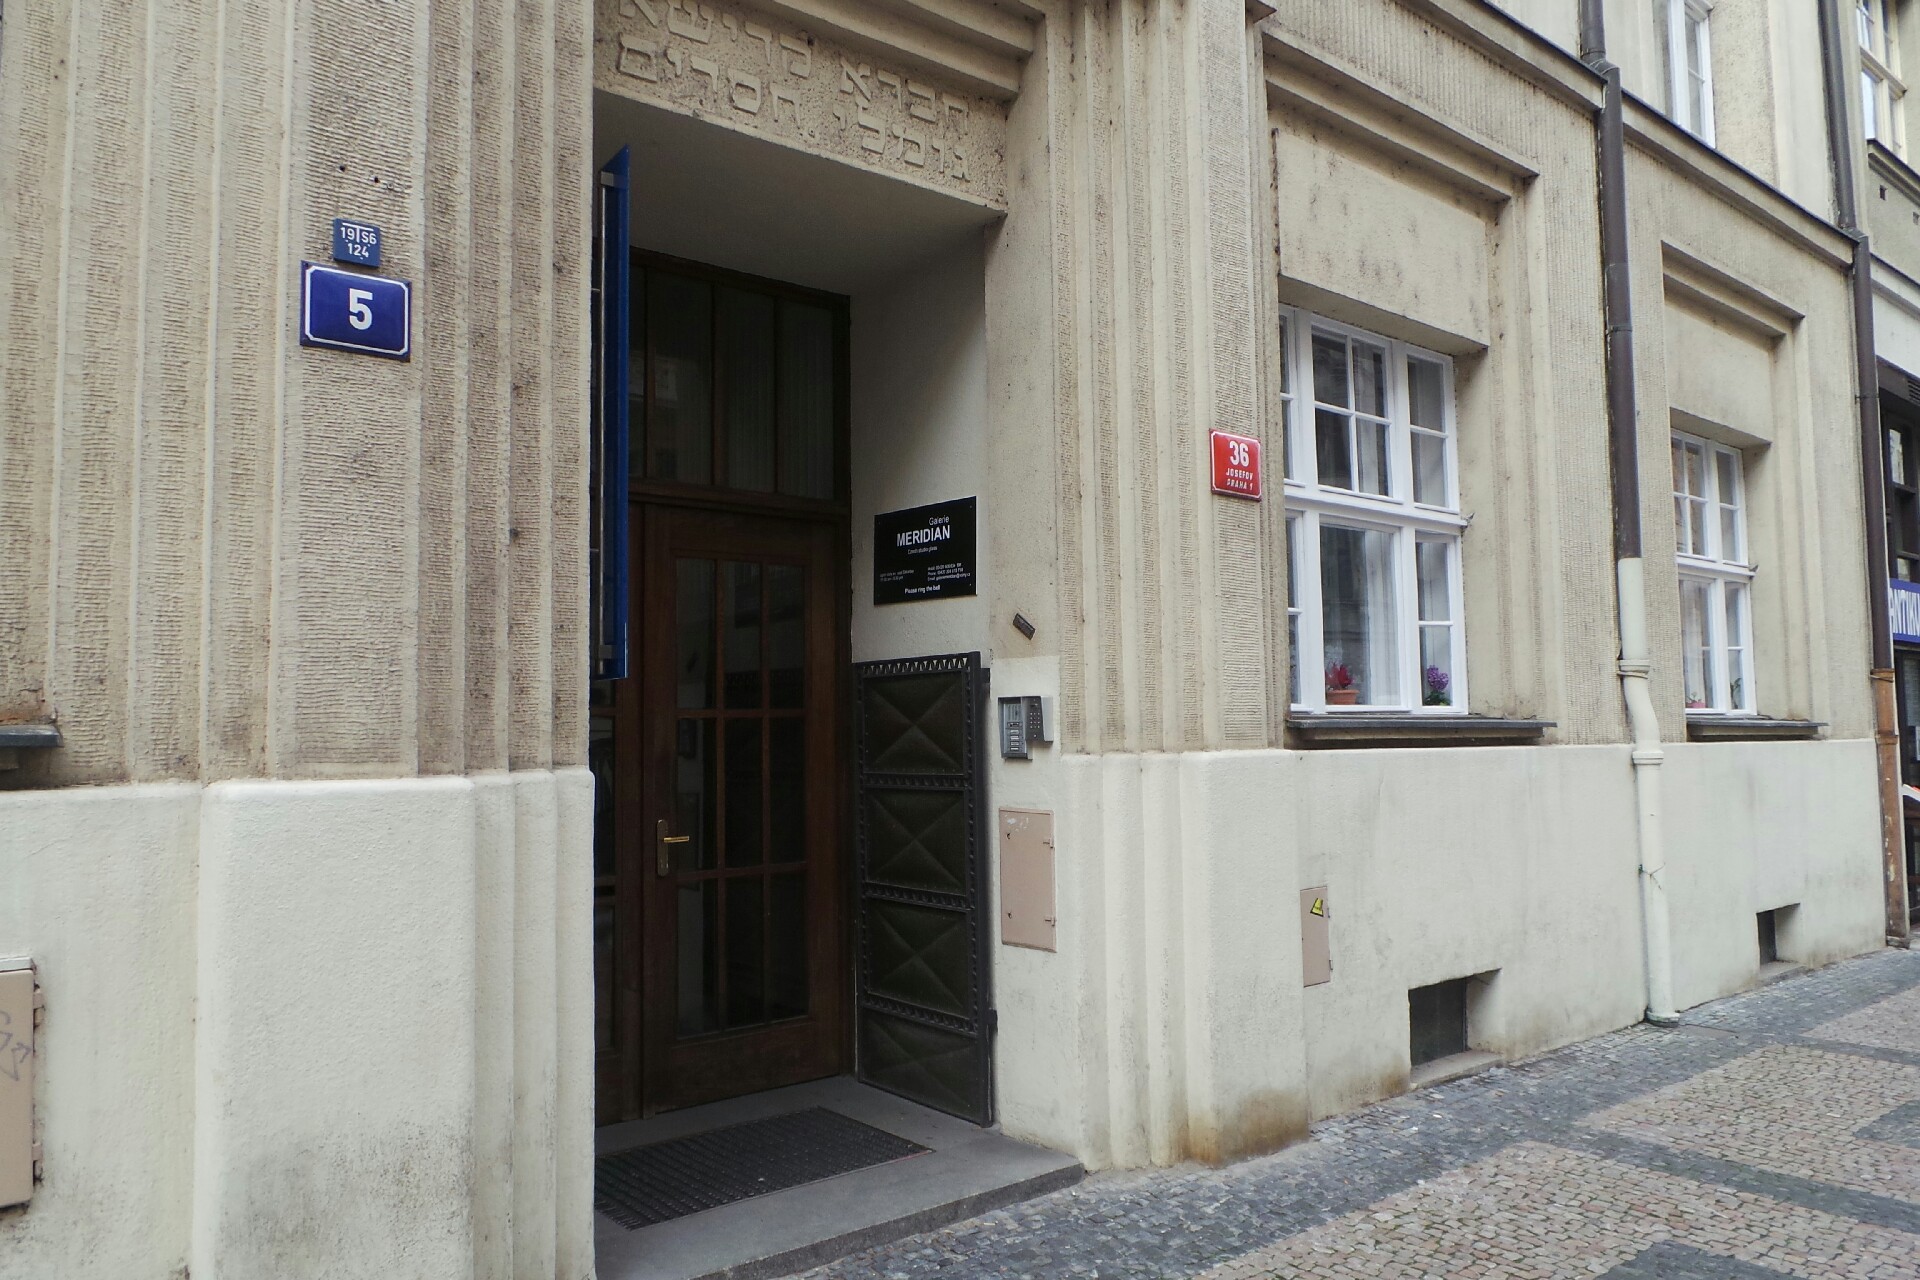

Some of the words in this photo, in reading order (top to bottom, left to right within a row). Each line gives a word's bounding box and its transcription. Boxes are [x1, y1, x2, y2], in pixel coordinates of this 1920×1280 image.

[617, 32, 802, 129] חסדים
[839, 56, 970, 135] חברא
[349, 287, 373, 330] 5
[1229, 440, 1250, 467] 36
[1226, 468, 1253, 480] JOSEFOV
[1227, 479, 1247, 489] PRAHA
[929, 515, 949, 525] Galerie
[897, 525, 950, 546] MERIDIAN
[917, 586, 926, 594] ring
